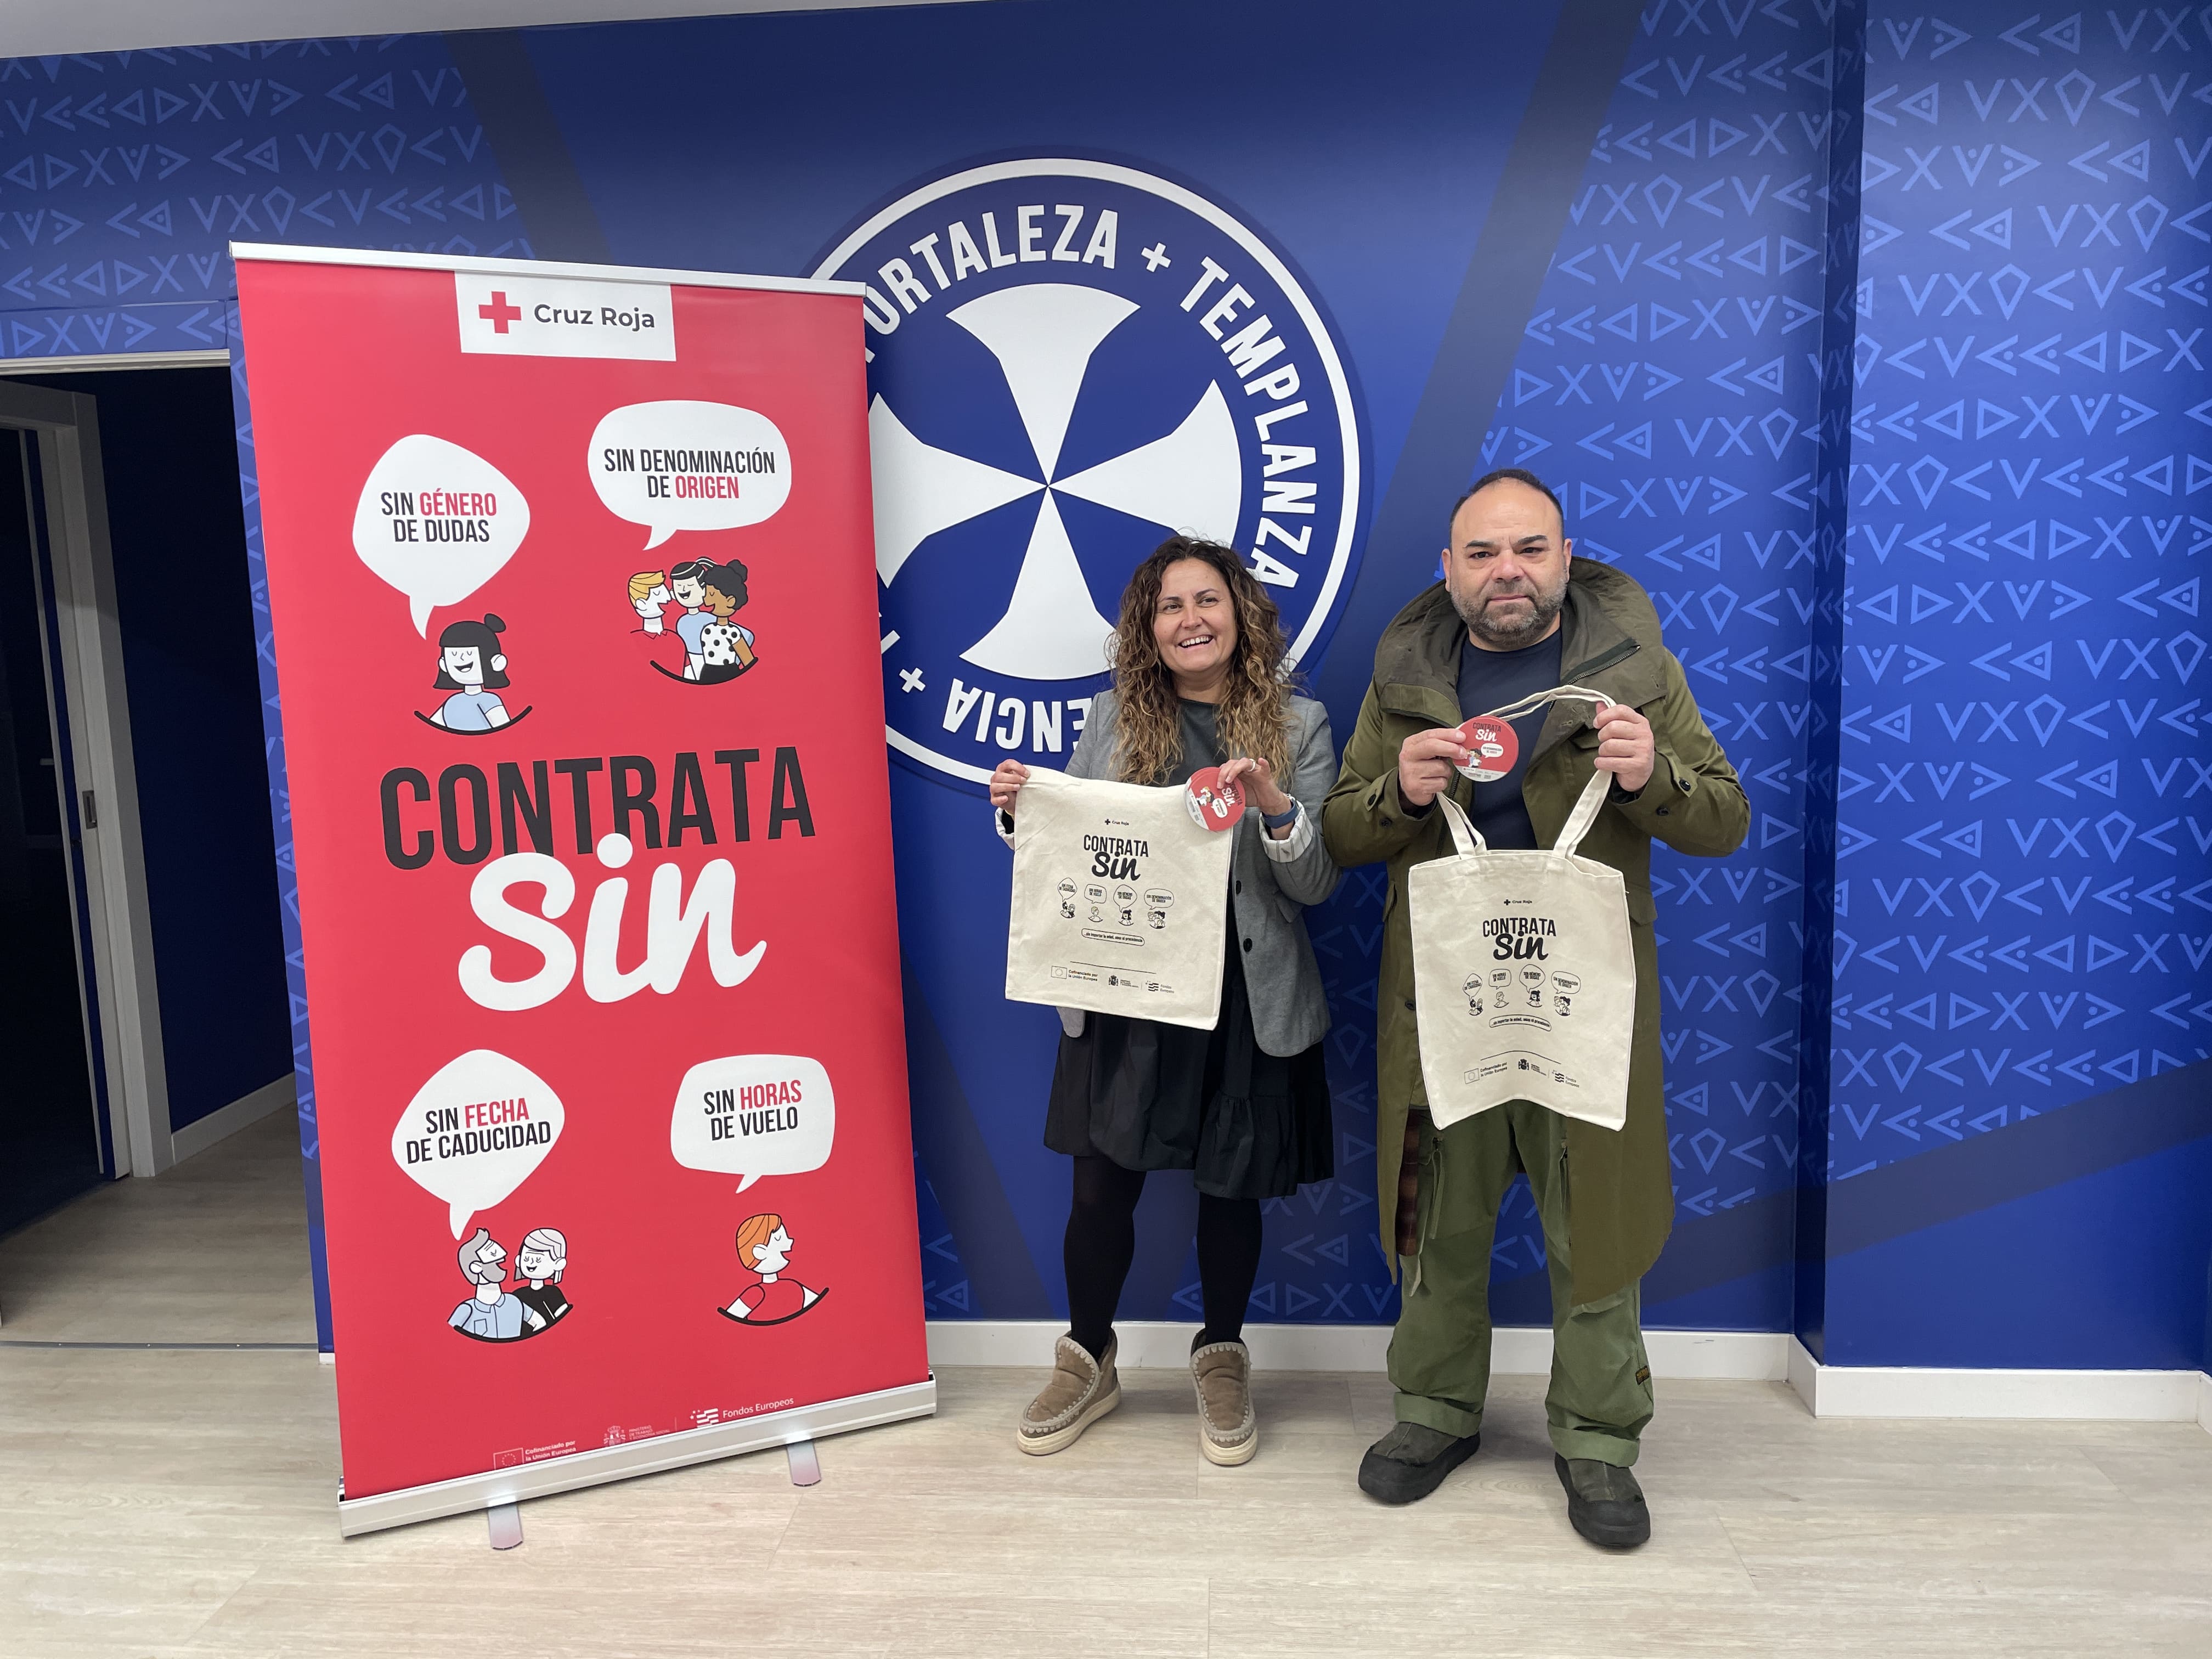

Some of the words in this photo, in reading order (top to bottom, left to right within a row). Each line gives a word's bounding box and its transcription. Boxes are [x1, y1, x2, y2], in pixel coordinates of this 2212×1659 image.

[864, 204, 1118, 363] ORTALEZA
[534, 304, 592, 324] Cruz
[601, 307, 654, 331] Roja
[1180, 256, 1317, 588] TEMPLANZA
[604, 449, 635, 471] SIN
[640, 447, 775, 473] DENOMINACIÓN
[647, 475, 670, 498] DE
[675, 475, 739, 498] ORIGEN
[381, 492, 414, 515] SIN
[420, 488, 496, 516] GÉNERO
[393, 519, 419, 542] DE
[425, 519, 490, 542] DUDAS
[943, 678, 1092, 752] ENCIA
[1473, 723, 1501, 732] CONTRATA
[1475, 729, 1497, 742] Sin
[380, 747, 815, 870] CONTRATA
[1084, 834, 1149, 857] CONTRATA
[1091, 851, 1141, 881] Sin
[458, 833, 767, 1011] Sin
[1483, 918, 1556, 937] CONTRATA
[1493, 931, 1549, 961] Sin
[703, 1089, 735, 1115] SIN
[740, 1080, 802, 1110] HORAS
[426, 1107, 459, 1134] SIN
[465, 1098, 529, 1128] FECHA
[711, 1116, 735, 1141] DE
[740, 1107, 798, 1136] VUELO
[406, 1138, 432, 1164] DE
[439, 1121, 551, 1159] CADUCIDAD
[723, 1407, 753, 1418] Fondos
[755, 1398, 794, 1412] Europeos
[525, 1442, 565, 1455] Cofinanciado
[551, 1447, 577, 1457] Europea
